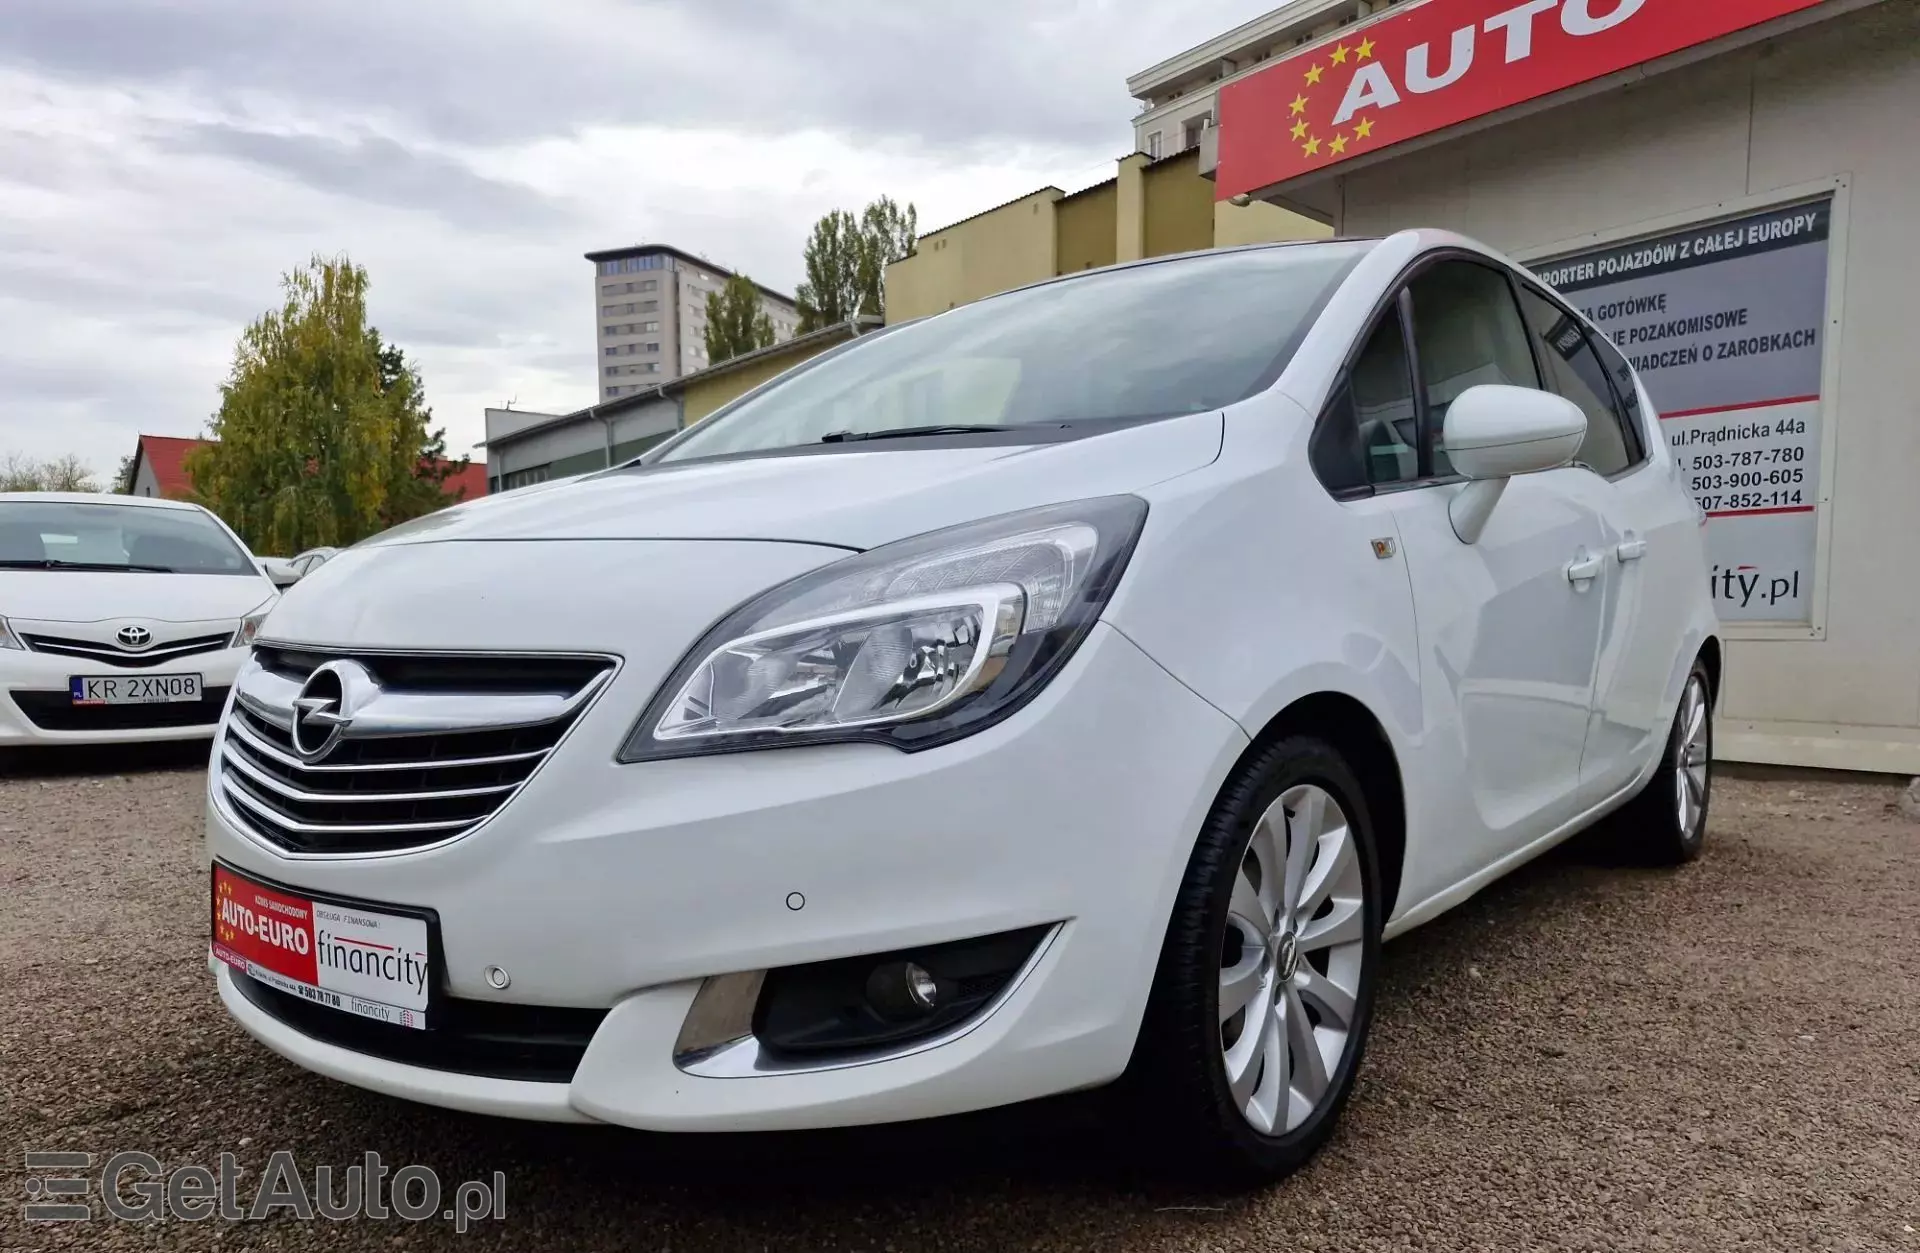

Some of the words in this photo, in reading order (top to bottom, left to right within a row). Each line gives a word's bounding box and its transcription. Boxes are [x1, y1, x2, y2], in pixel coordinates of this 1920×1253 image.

[1598, 243, 1677, 277] POJAZDÓW
[1679, 241, 1690, 259] Z
[1694, 228, 1744, 256] CAŁEJ
[1748, 212, 1816, 245] EUROPY
[1597, 293, 1667, 321] GOTÓWKĘ
[1629, 308, 1748, 345] POZAKOMISOWE
[1702, 345, 1713, 361] O
[1717, 328, 1816, 360] ZAROBKACH
[1775, 418, 1806, 435] 44a
[1692, 446, 1805, 471] 503-787-780
[1691, 468, 1804, 491] 503-900-605
[88, 680, 117, 699] KR
[127, 677, 196, 698] 2XN08
[222, 897, 309, 955] AUTO-EURO
[318, 930, 428, 995] financity
[351, 996, 390, 1021] financity
